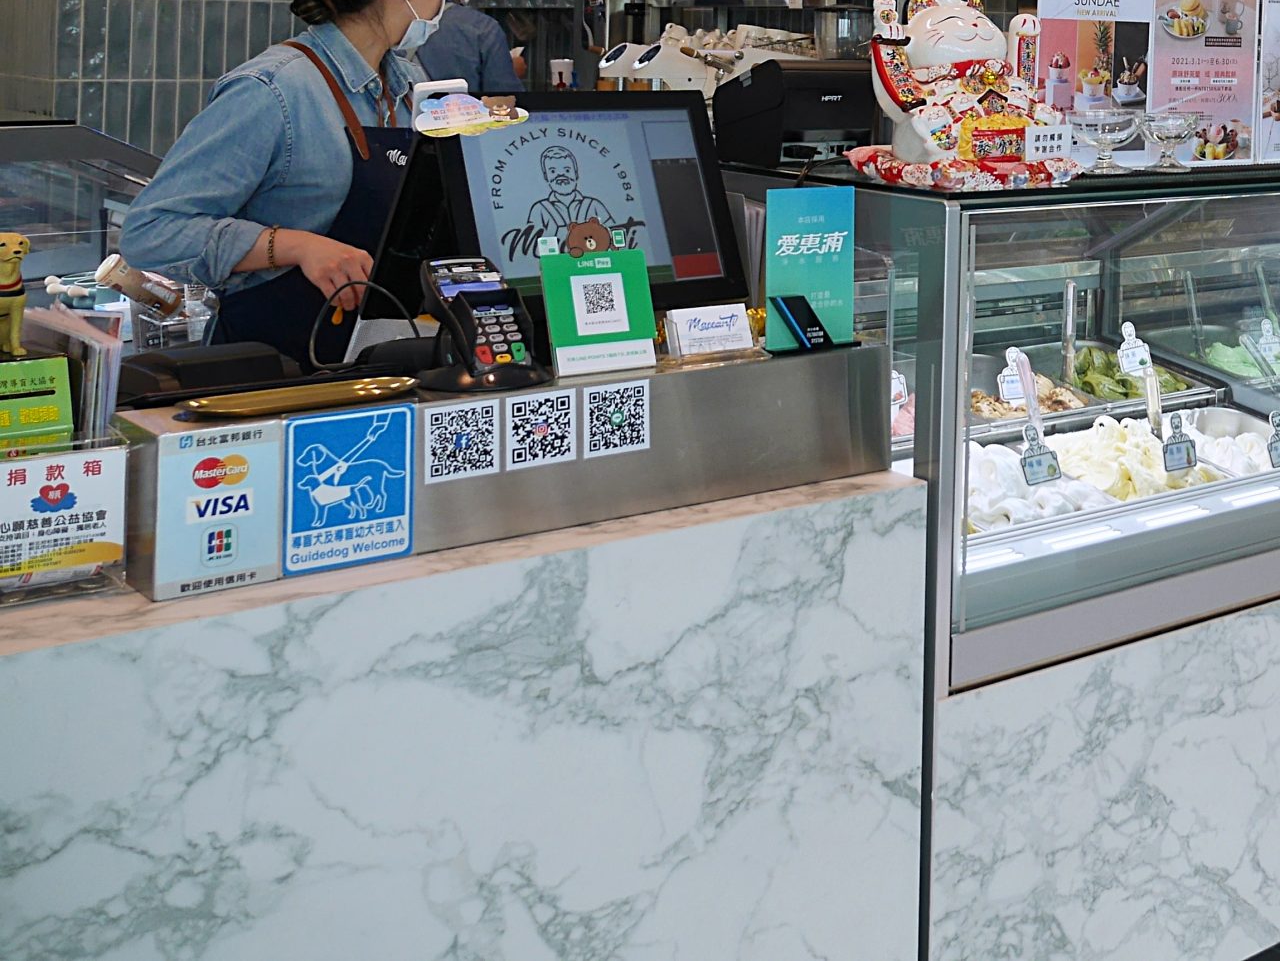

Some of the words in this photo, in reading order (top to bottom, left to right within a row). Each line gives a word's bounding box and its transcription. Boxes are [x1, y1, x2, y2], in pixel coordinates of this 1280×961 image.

[1091, 9, 1117, 17] ARRIVAL
[491, 159, 507, 210] FROM
[504, 127, 549, 157] ITALY
[557, 127, 611, 157] SINCE
[612, 162, 634, 203] 1984
[577, 260, 595, 268] LINE
[196, 429, 263, 447] 台北富邦銀行
[7, 460, 102, 487] 捐款箱
[193, 463, 248, 480] MasterCard
[191, 494, 249, 518] VISA
[292, 519, 405, 549] 導盲犬及導盲幼犬可進入
[290, 547, 349, 565] Guidedog
[352, 537, 405, 554] Welcome
[180, 572, 256, 593] 歡迎使用信用卡
